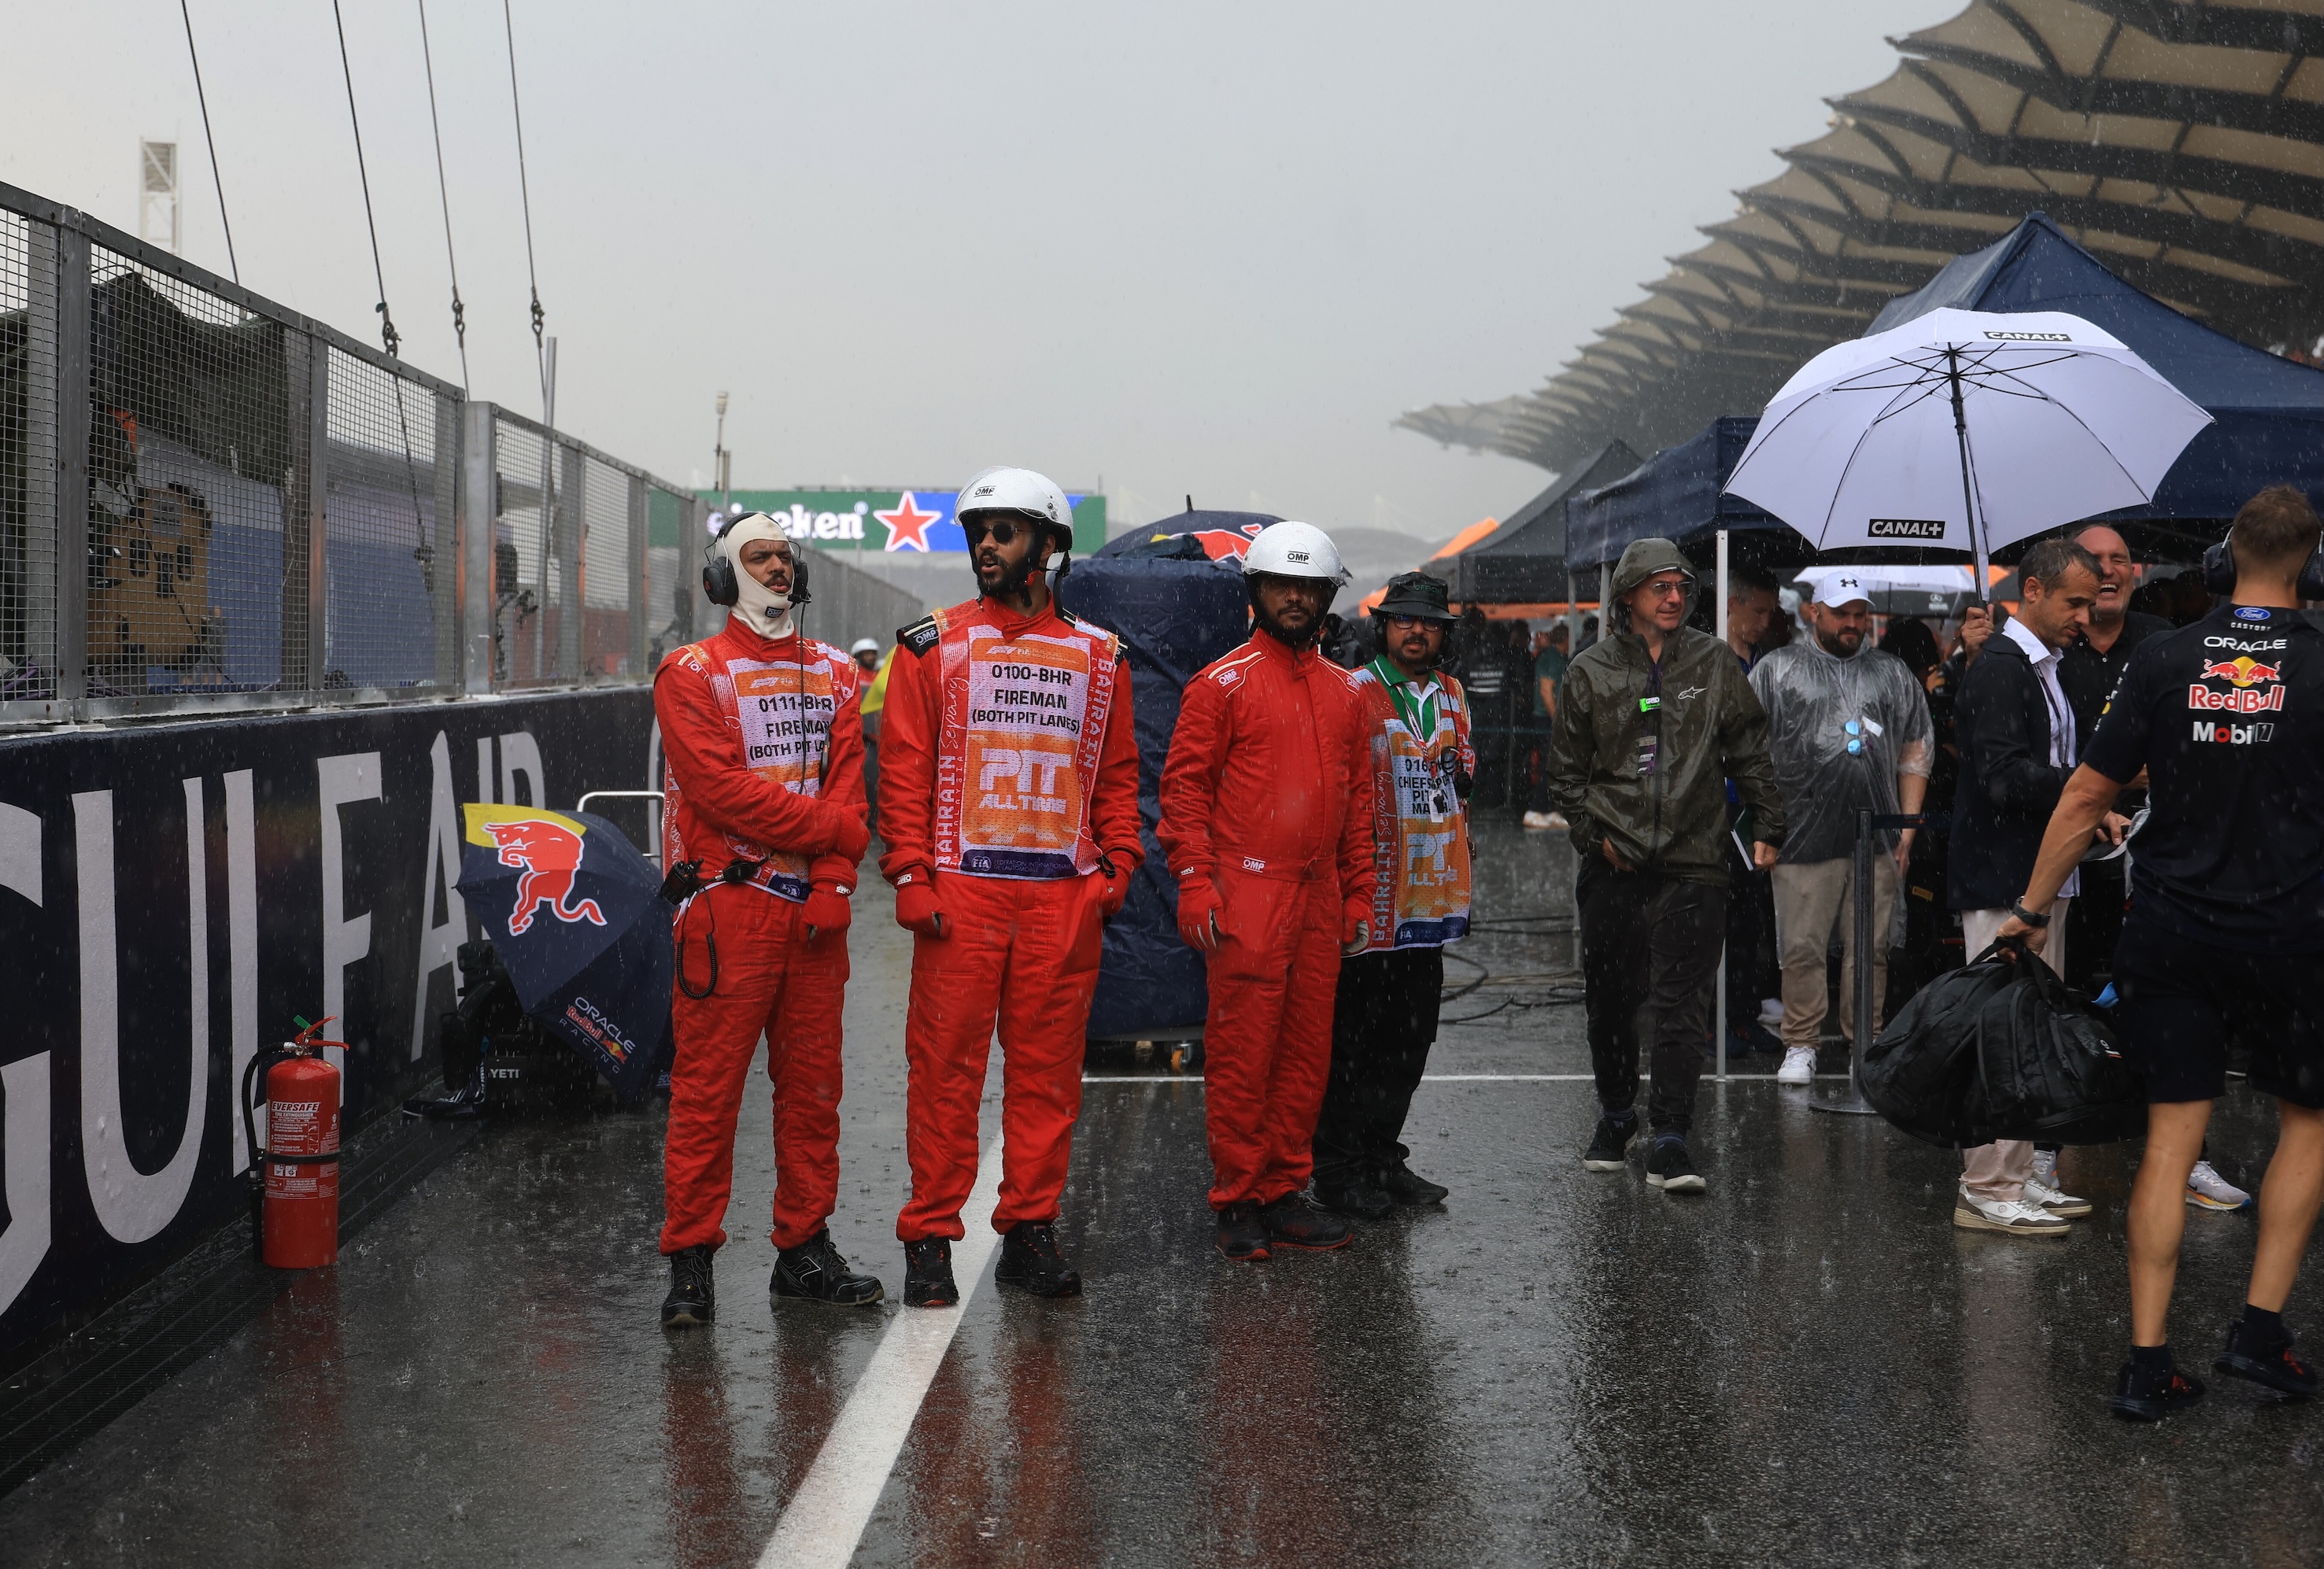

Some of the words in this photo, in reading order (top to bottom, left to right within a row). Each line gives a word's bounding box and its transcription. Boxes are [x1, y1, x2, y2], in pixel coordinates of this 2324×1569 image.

[1986, 331, 2068, 341] CANAL+
[974, 487, 996, 496] OMP
[1871, 520, 1942, 537] CANAL+
[1287, 552, 1310, 563] OMP
[2240, 608, 2265, 620] Ford
[915, 629, 937, 644] OMP
[2203, 636, 2288, 653] ORACLE
[992, 664, 1072, 686] 0100-BHR
[1218, 670, 1238, 685] OMP
[994, 689, 1067, 710] FIREMAN
[972, 708, 1014, 724] (BOTH
[1018, 711, 1037, 725] PIT
[1040, 714, 1081, 735] LANES)
[1085, 656, 1114, 770] BAHRAIN
[2193, 721, 2256, 745] Mobi
[749, 742, 792, 761] (BOTH
[980, 748, 1072, 795] PIT
[936, 755, 956, 866] BAHRAIN
[978, 793, 1018, 810] ALL
[1018, 795, 1067, 814] TIME
[973, 858, 989, 869] FIA
[1243, 859, 1265, 871] OMP
[1372, 841, 1391, 942] BAHRAIN
[575, 995, 636, 1054] ORACLE
[559, 1017, 621, 1074] RACING
[490, 1069, 520, 1079] YETI
[272, 1102, 319, 1111] EVERSAFE
